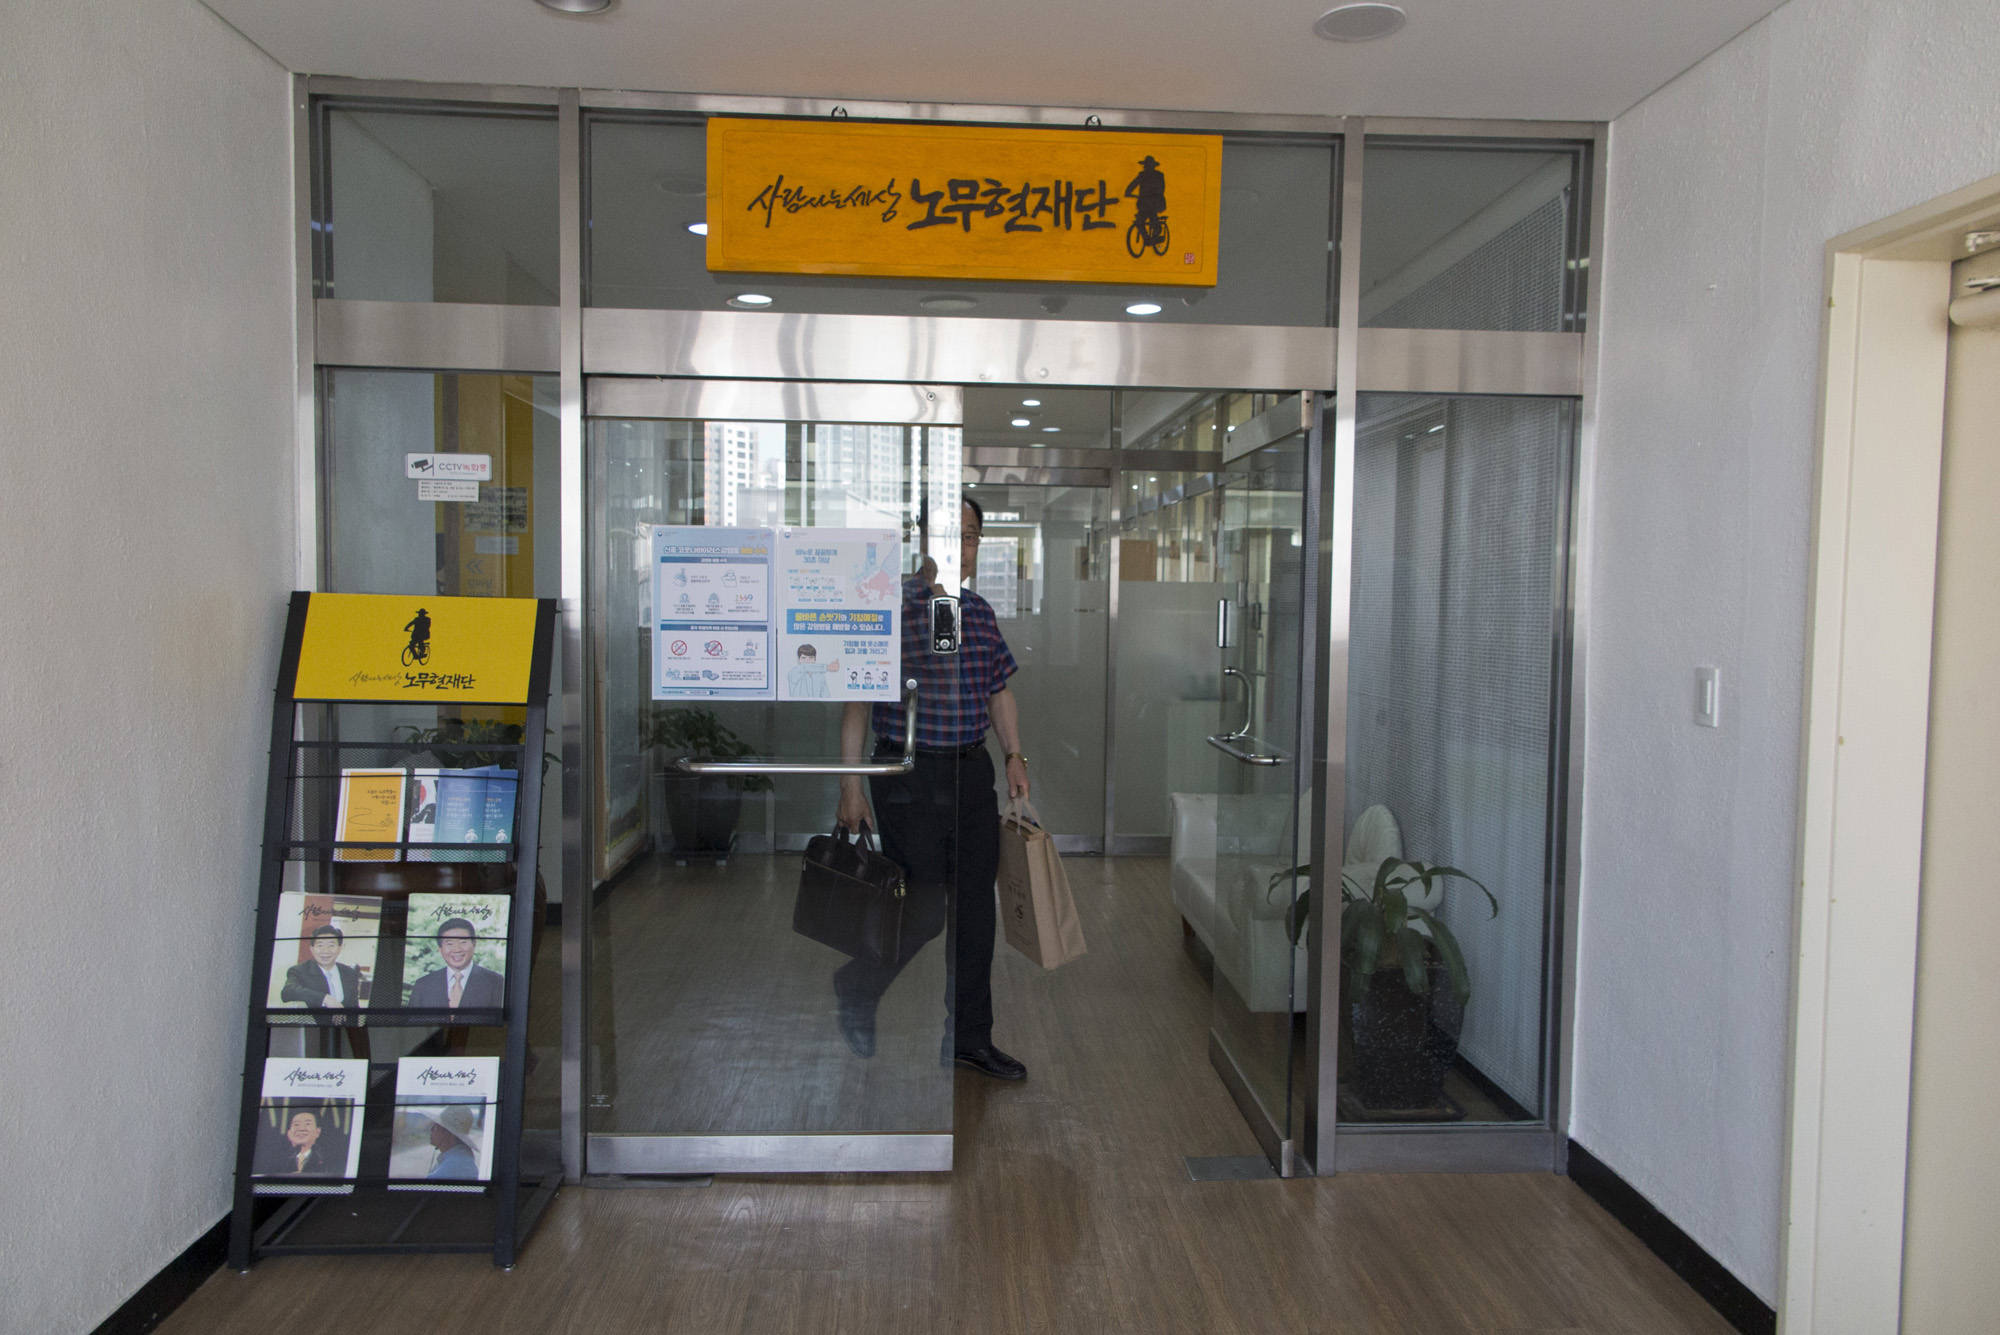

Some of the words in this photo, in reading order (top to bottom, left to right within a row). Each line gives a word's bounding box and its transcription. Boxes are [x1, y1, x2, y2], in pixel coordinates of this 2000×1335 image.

[905, 177, 1120, 233] 노무현재단
[851, 624, 858, 632] 수
[401, 671, 477, 690] 노무현재단
